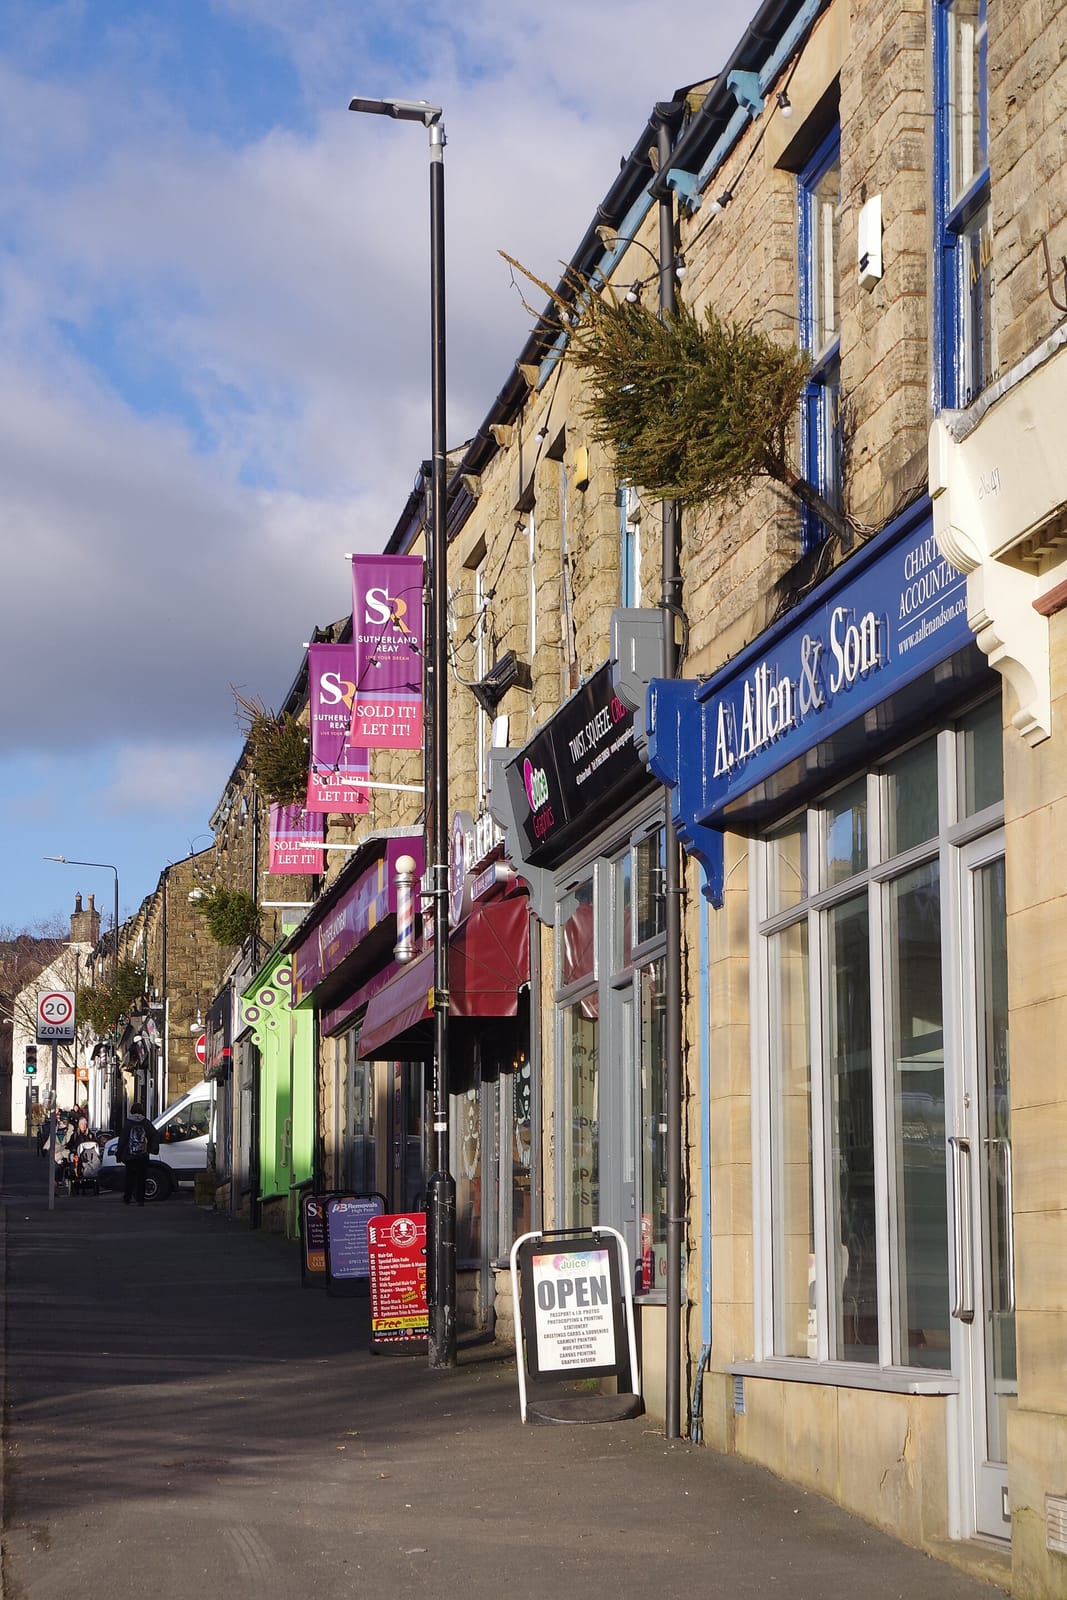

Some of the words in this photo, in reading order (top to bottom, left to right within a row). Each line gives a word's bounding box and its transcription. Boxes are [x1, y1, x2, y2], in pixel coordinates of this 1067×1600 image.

[357, 635, 418, 645] SUTHERLAND
[376, 644, 400, 654] REAY
[713, 701, 735, 778] A.
[739, 661, 794, 760] Allen
[799, 634, 823, 715] &
[830, 607, 879, 693] Son
[357, 704, 395, 719] SOLD
[396, 705, 417, 719] IT!
[362, 722, 390, 736] LET
[391, 722, 411, 736] IT!
[568, 730, 589, 764] TWIST.
[585, 706, 613, 749] SQUEEZE.
[312, 774, 342, 786] SOLD
[317, 791, 343, 802] LET
[344, 791, 361, 803] IT!
[273, 841, 300, 851] SOLD
[279, 854, 302, 865] LET
[303, 854, 316, 865] IT!
[45, 1003, 67, 1016] 20
[40, 1026, 71, 1035] ZONE
[560, 1259, 587, 1270] Juice
[537, 1275, 609, 1311] OPEN
[374, 1319, 402, 1330] Free
[563, 1323, 588, 1331] STATIONERY
[543, 1331, 566, 1339] GREETINGS
[557, 1337, 576, 1345] GARMENT
